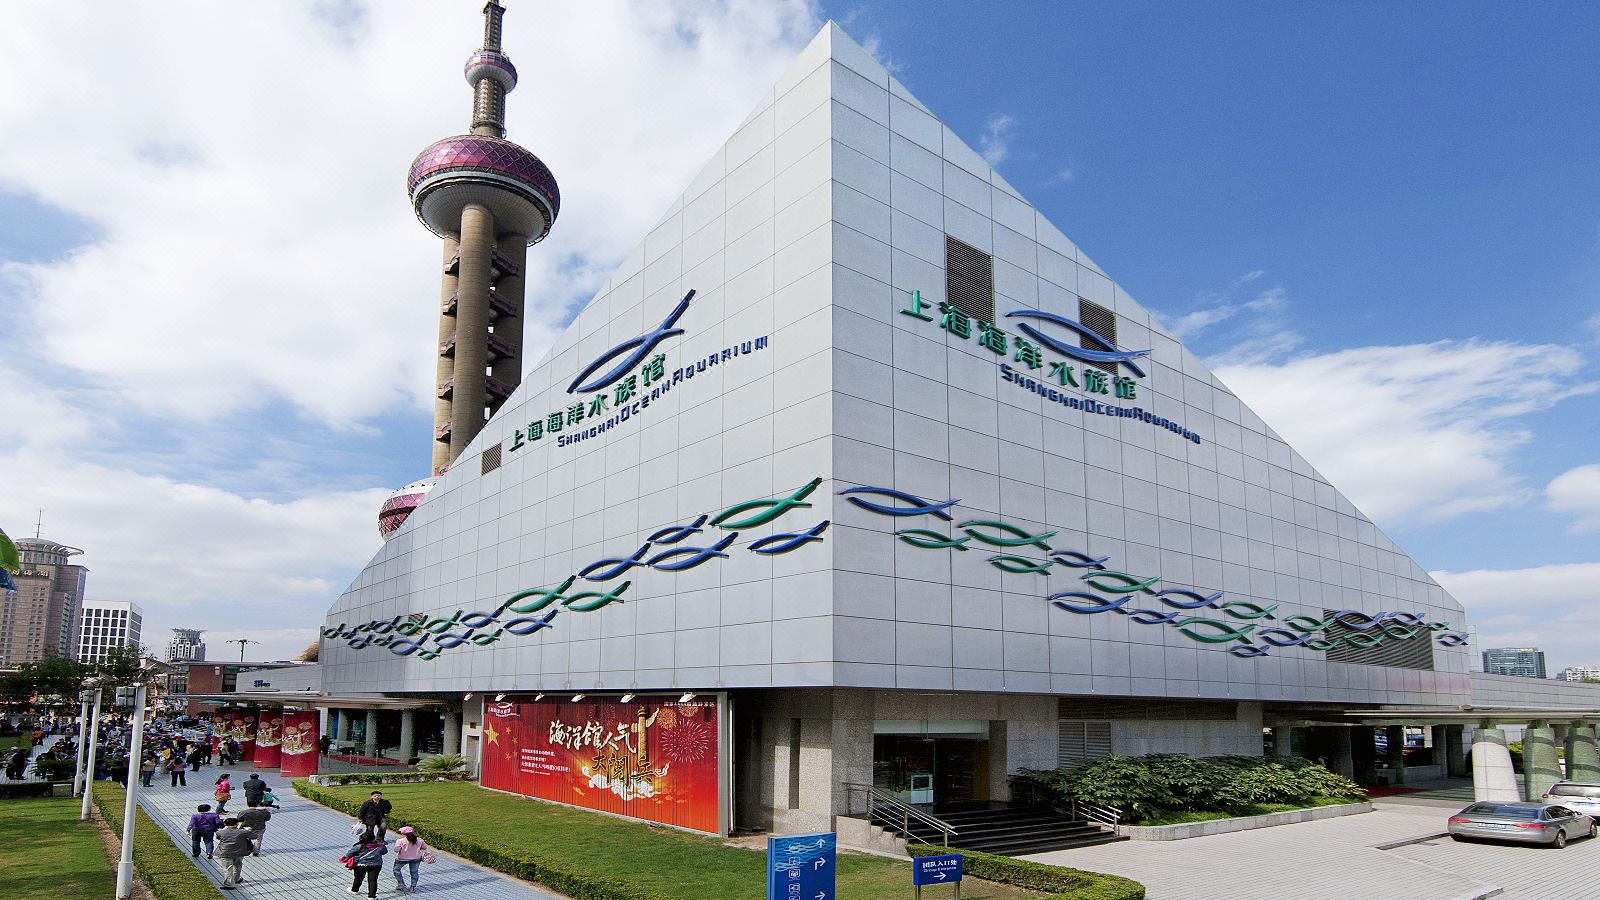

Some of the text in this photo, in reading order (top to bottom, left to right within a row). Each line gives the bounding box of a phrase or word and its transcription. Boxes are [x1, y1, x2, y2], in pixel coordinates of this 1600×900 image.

[900, 289, 1137, 400] 上海海洋水族馆
[509, 353, 666, 451] 上海海洋水族馆
[549, 719, 637, 754] 海洋馆人气
